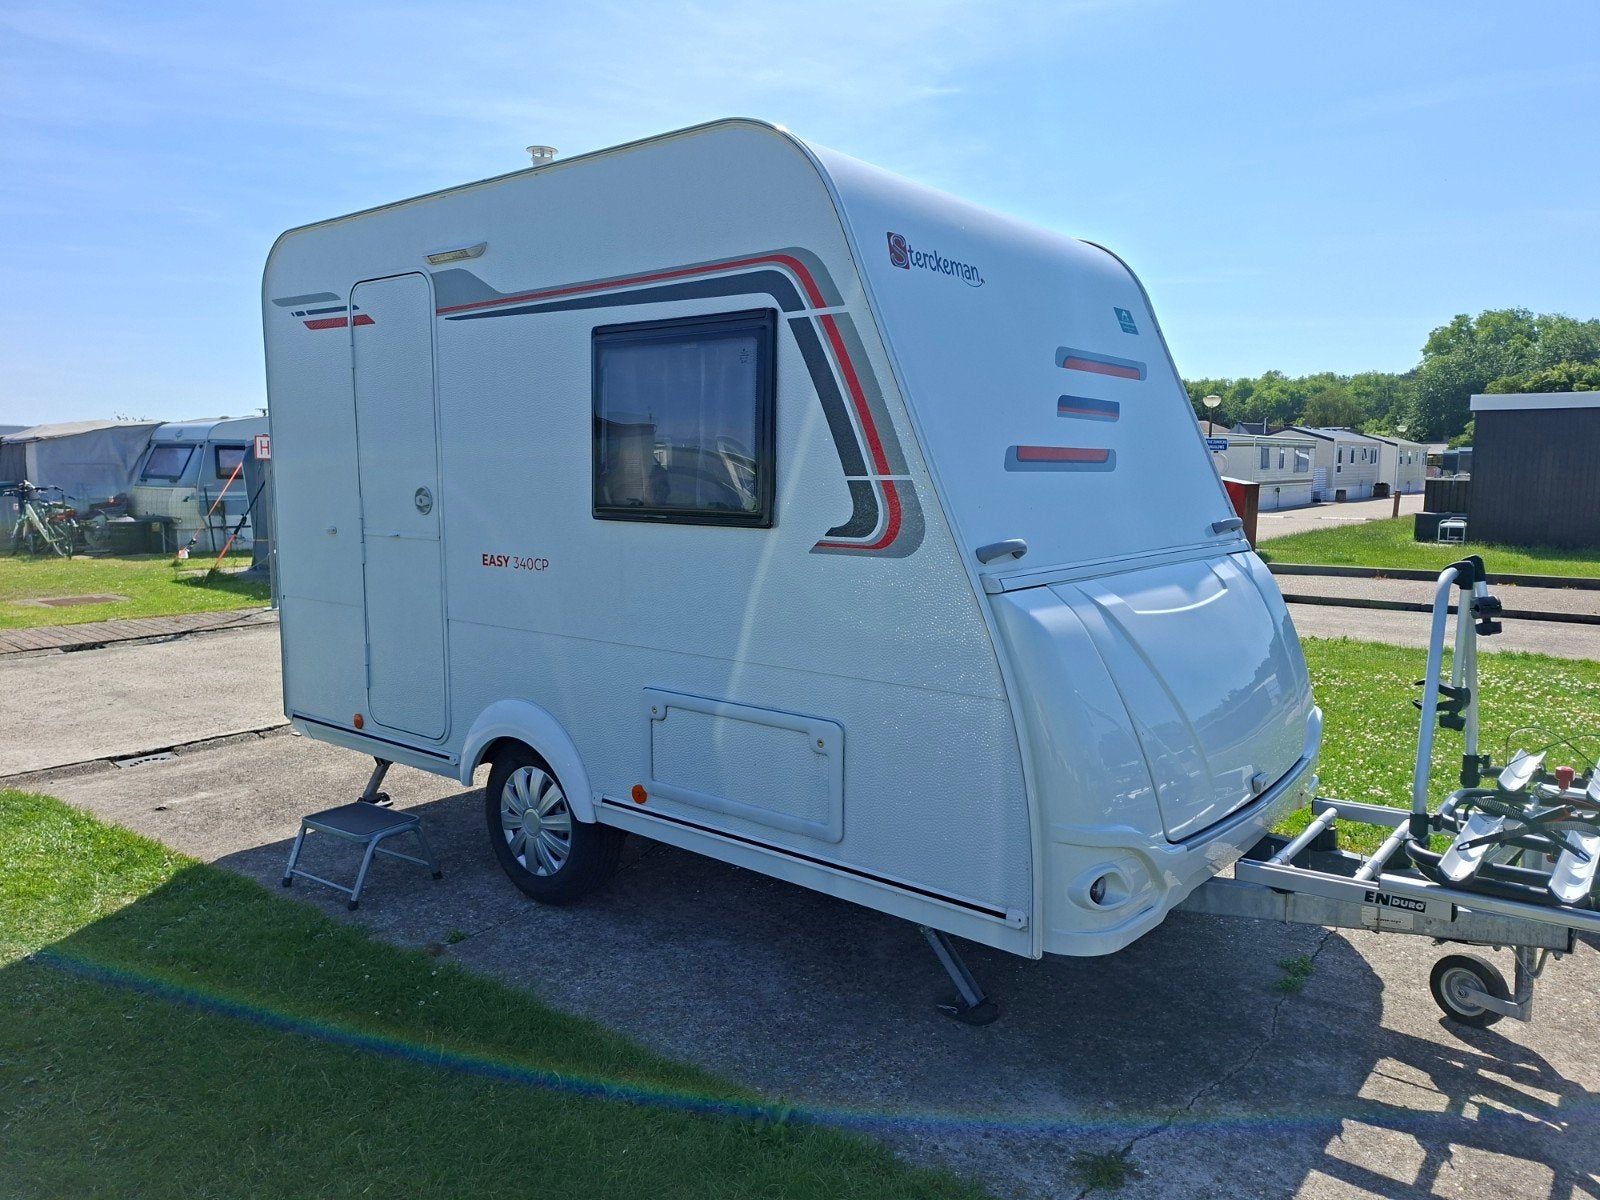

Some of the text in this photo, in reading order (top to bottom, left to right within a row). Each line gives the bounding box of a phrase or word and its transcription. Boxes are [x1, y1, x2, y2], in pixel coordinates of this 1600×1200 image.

[887, 232, 983, 286] Sterckeman
[260, 440, 270, 455] H
[482, 553, 549, 571] EASY 340CP
[1365, 890, 1426, 912] ENDURO
